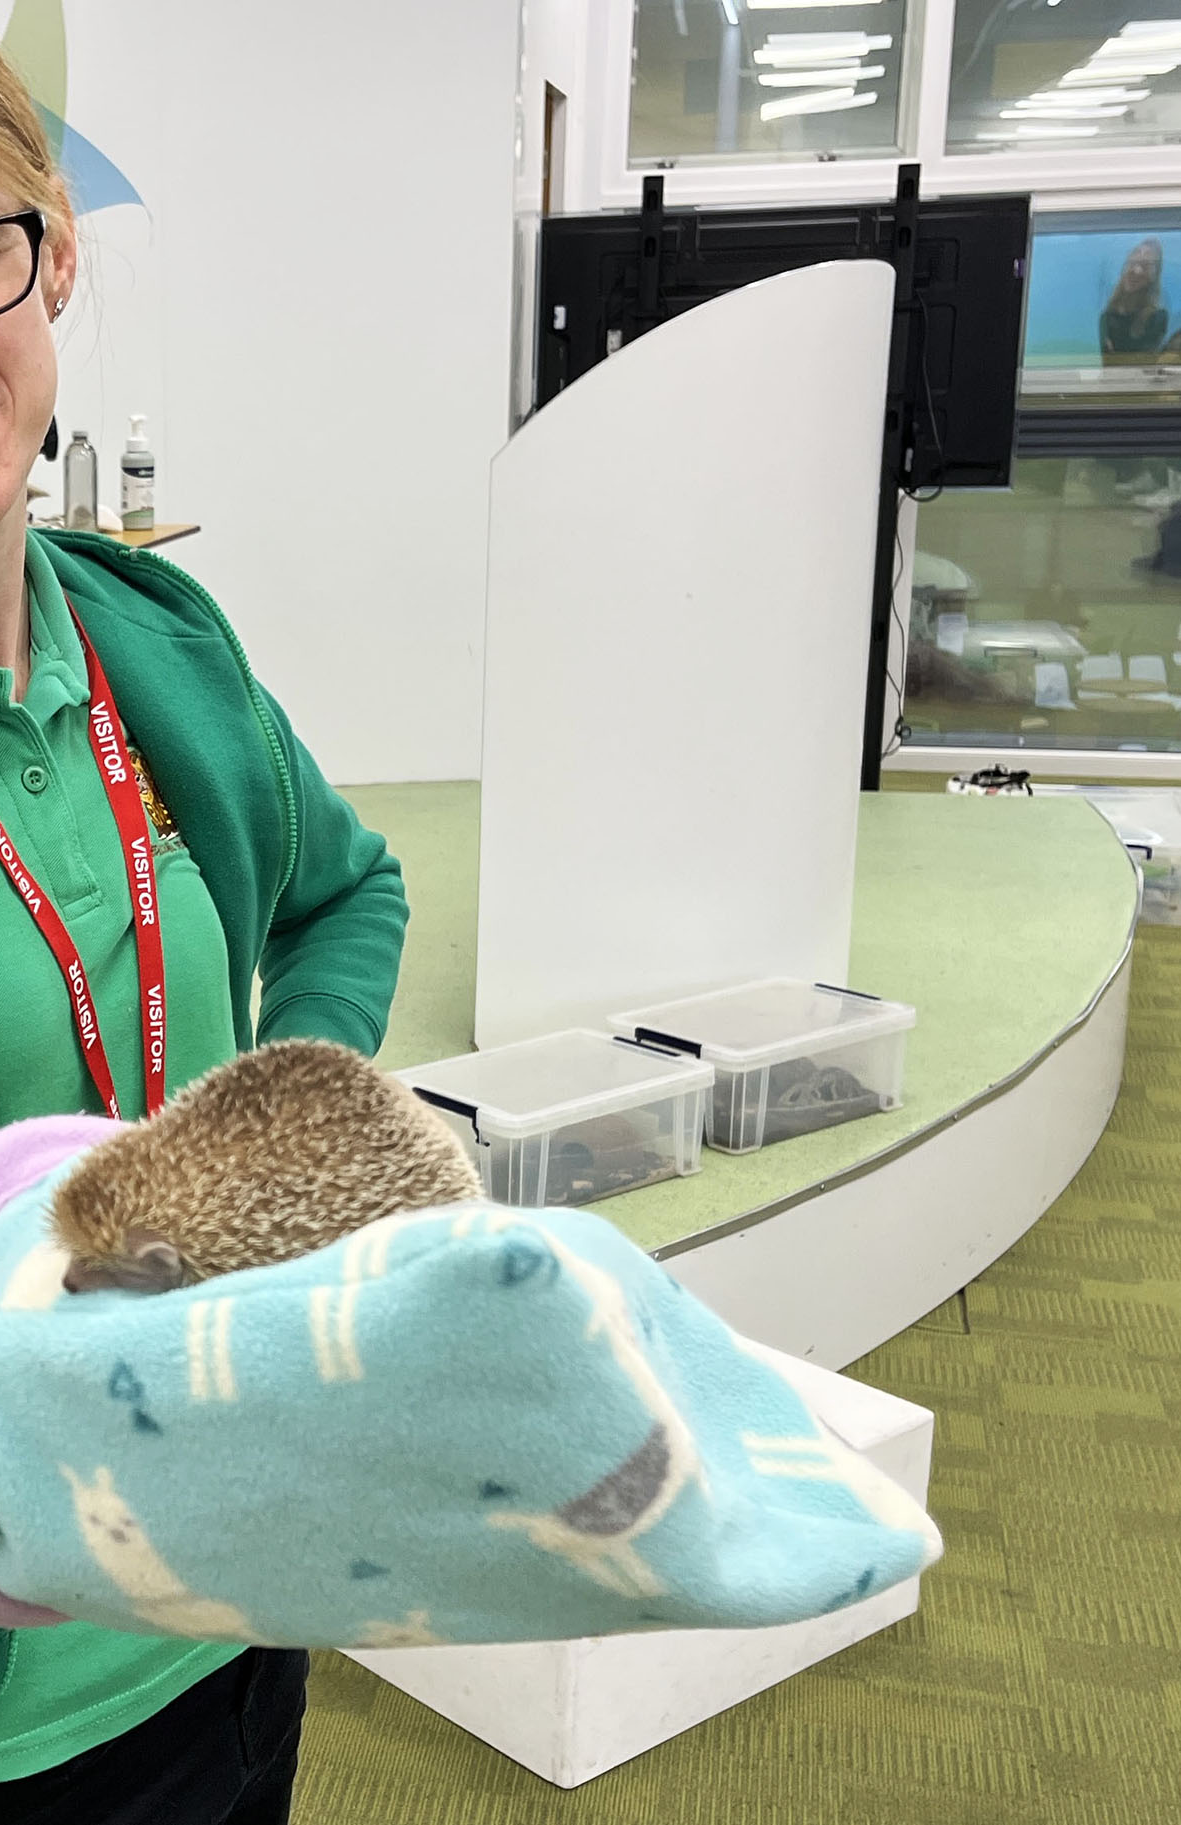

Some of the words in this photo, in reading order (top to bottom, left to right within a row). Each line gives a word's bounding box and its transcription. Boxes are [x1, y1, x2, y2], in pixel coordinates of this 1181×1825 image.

[90, 701, 127, 785] VISITOR
[131, 836, 155, 926] VISITOR
[68, 960, 97, 1050] VISITOR
[147, 984, 164, 1075] VISITOR
